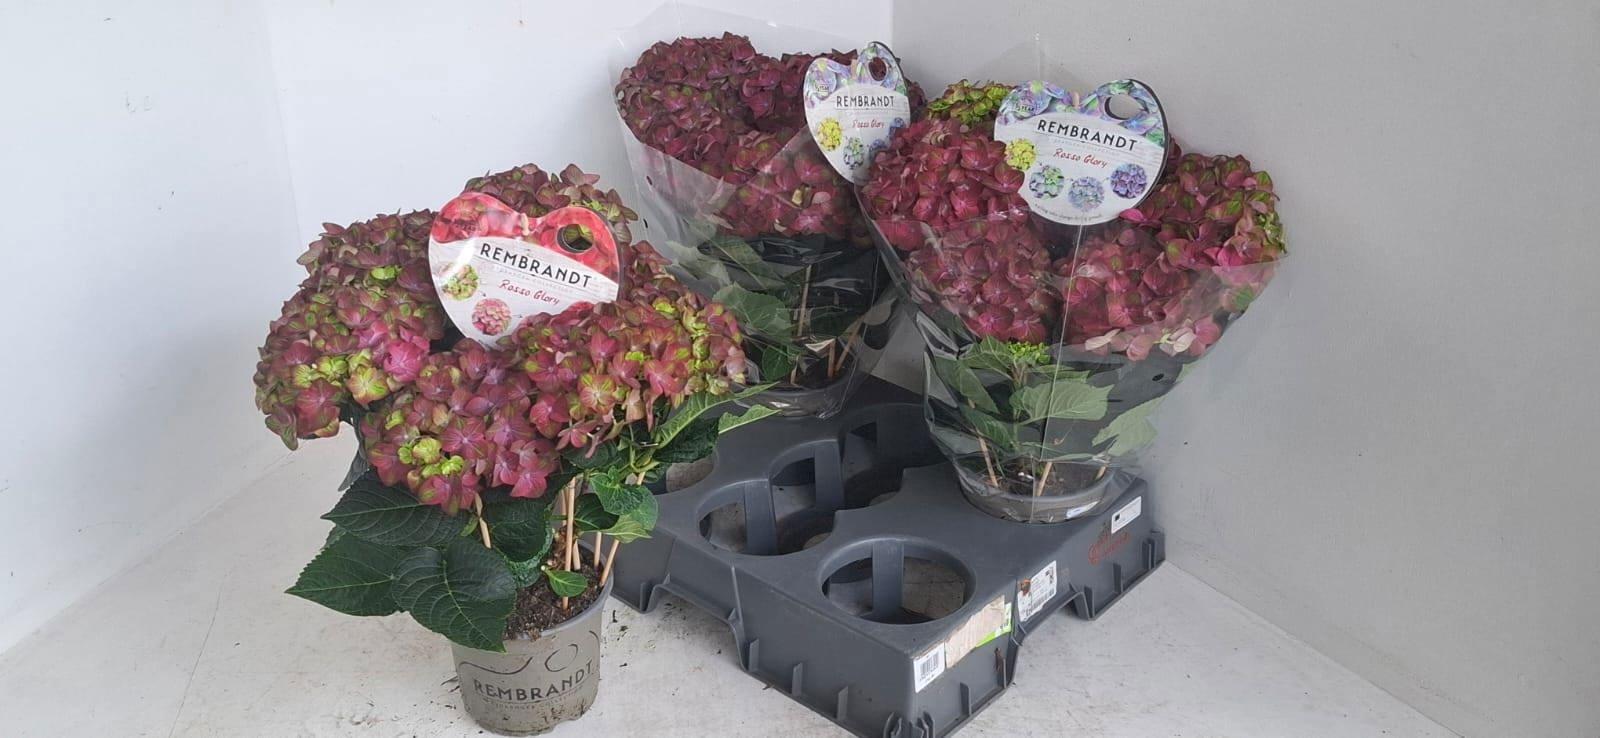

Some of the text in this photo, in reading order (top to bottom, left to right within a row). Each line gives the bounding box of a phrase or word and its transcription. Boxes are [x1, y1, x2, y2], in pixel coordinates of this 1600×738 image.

[836, 95, 895, 108] REMBRANDT
[1036, 119, 1138, 152] REMBRANDT
[1053, 147, 1081, 161] Rosso
[1083, 153, 1108, 168] Glory
[480, 242, 593, 288] REMBRANDT
[498, 278, 531, 297] Rosso
[533, 289, 560, 306] Glory
[472, 658, 594, 701] REMBRANDT
